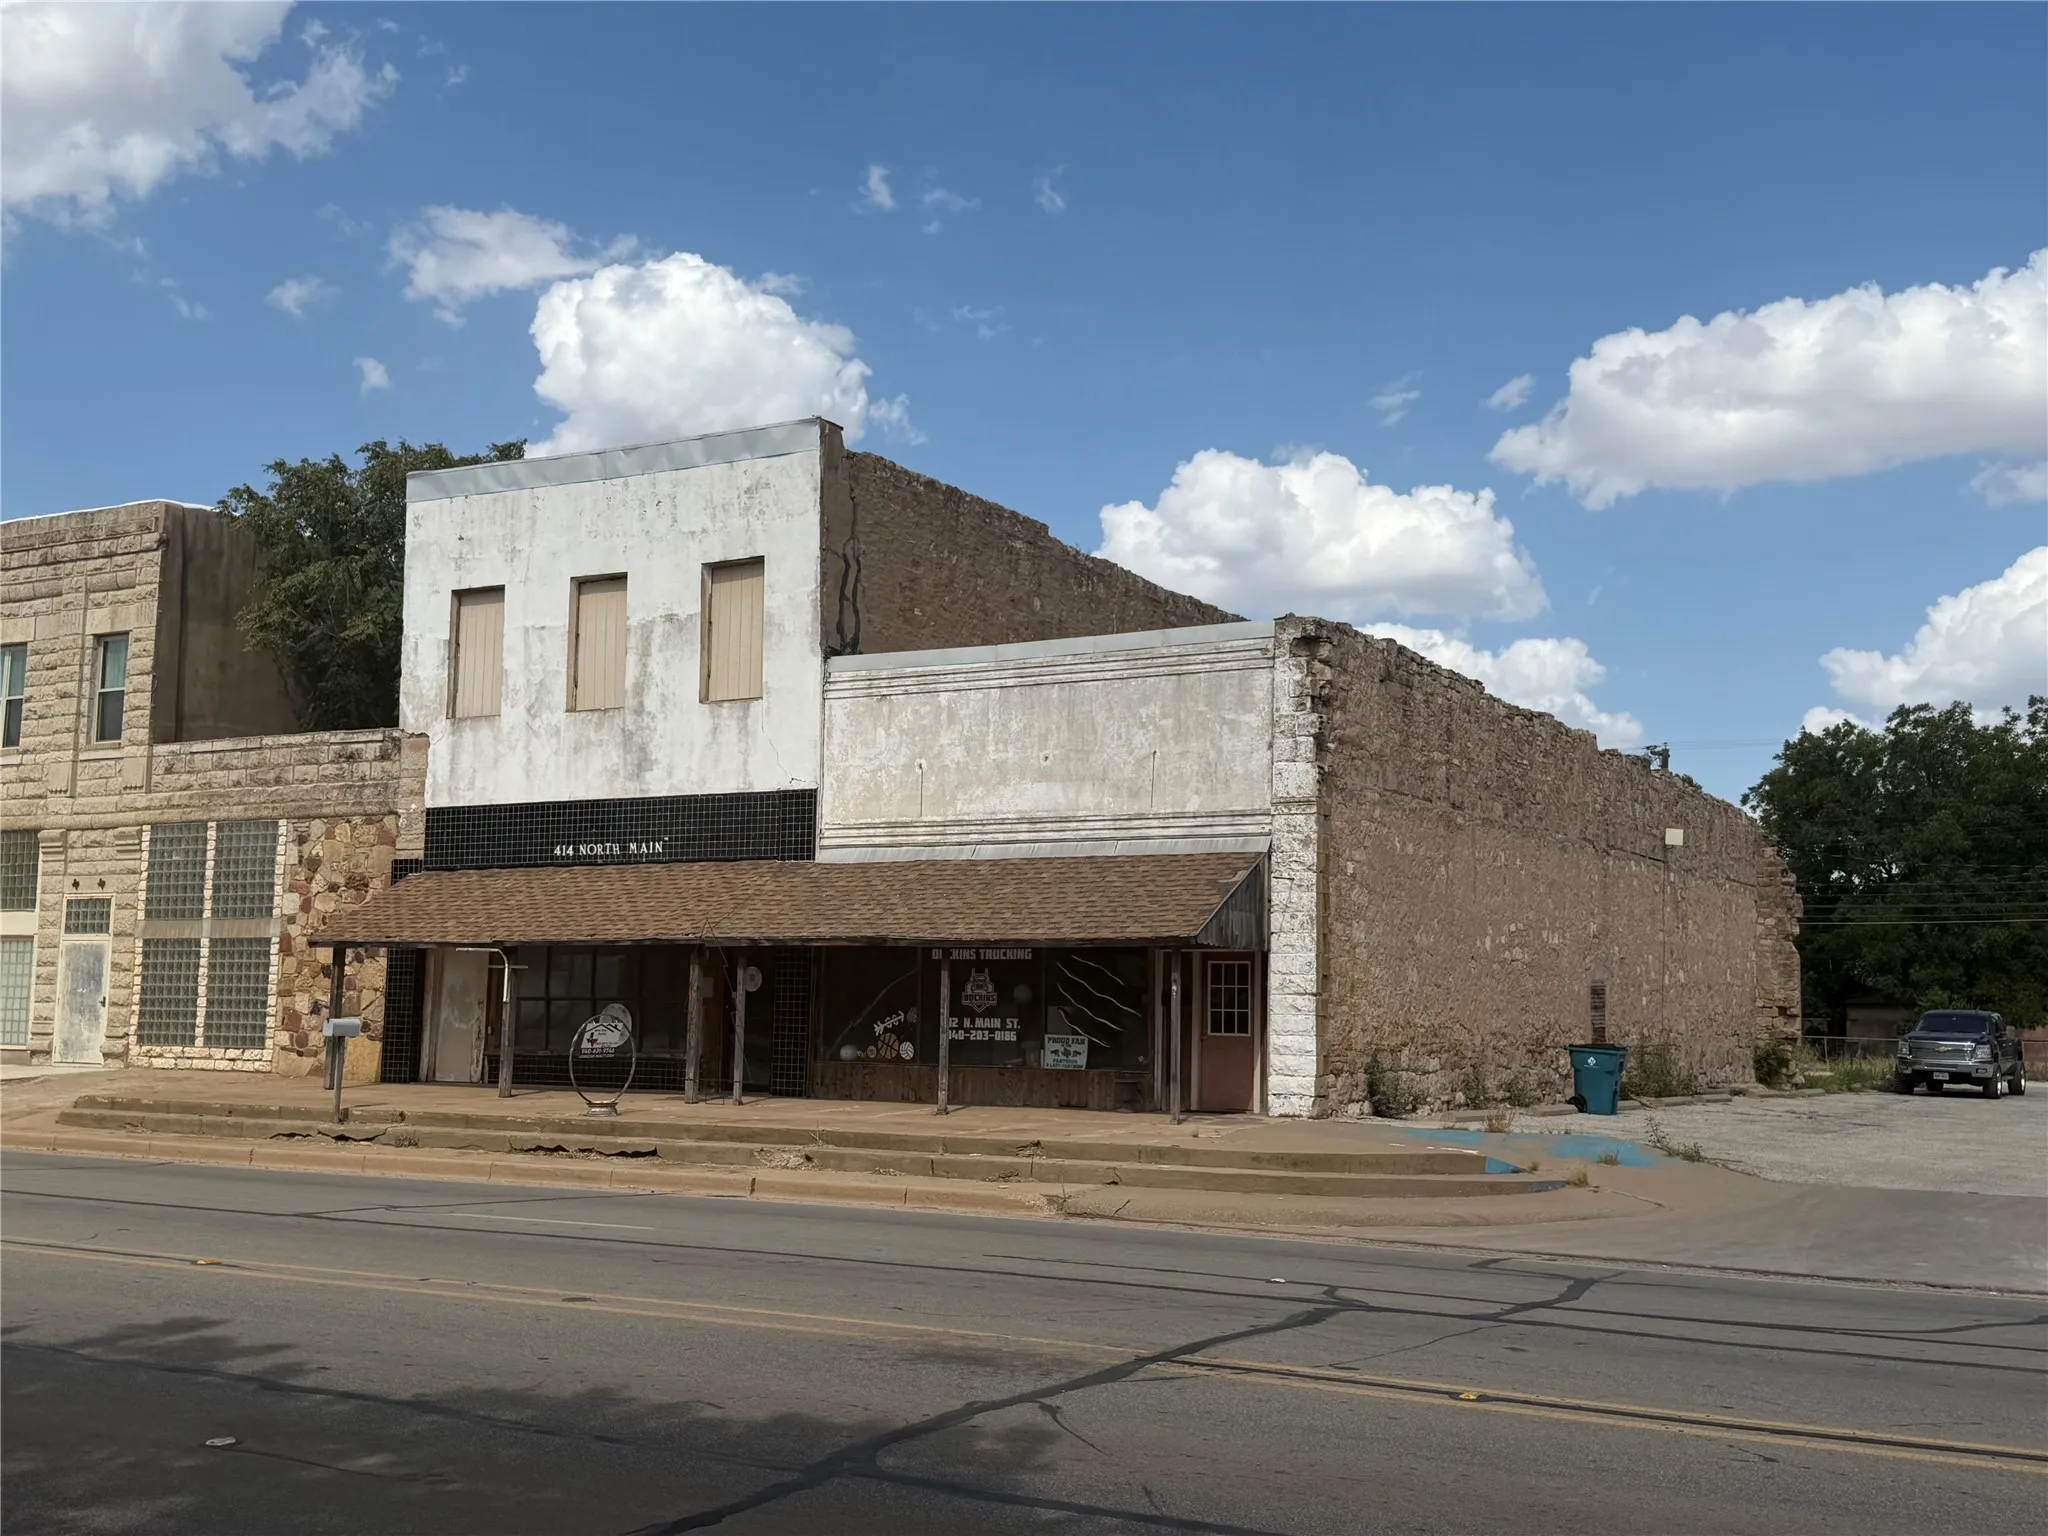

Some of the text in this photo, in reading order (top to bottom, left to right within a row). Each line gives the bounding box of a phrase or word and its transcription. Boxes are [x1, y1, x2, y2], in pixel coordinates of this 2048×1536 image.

[554, 841, 663, 857] 414 NORTH MAIN
[979, 948, 1033, 960] TRUCKING
[1006, 1017, 1021, 1029] ST.
